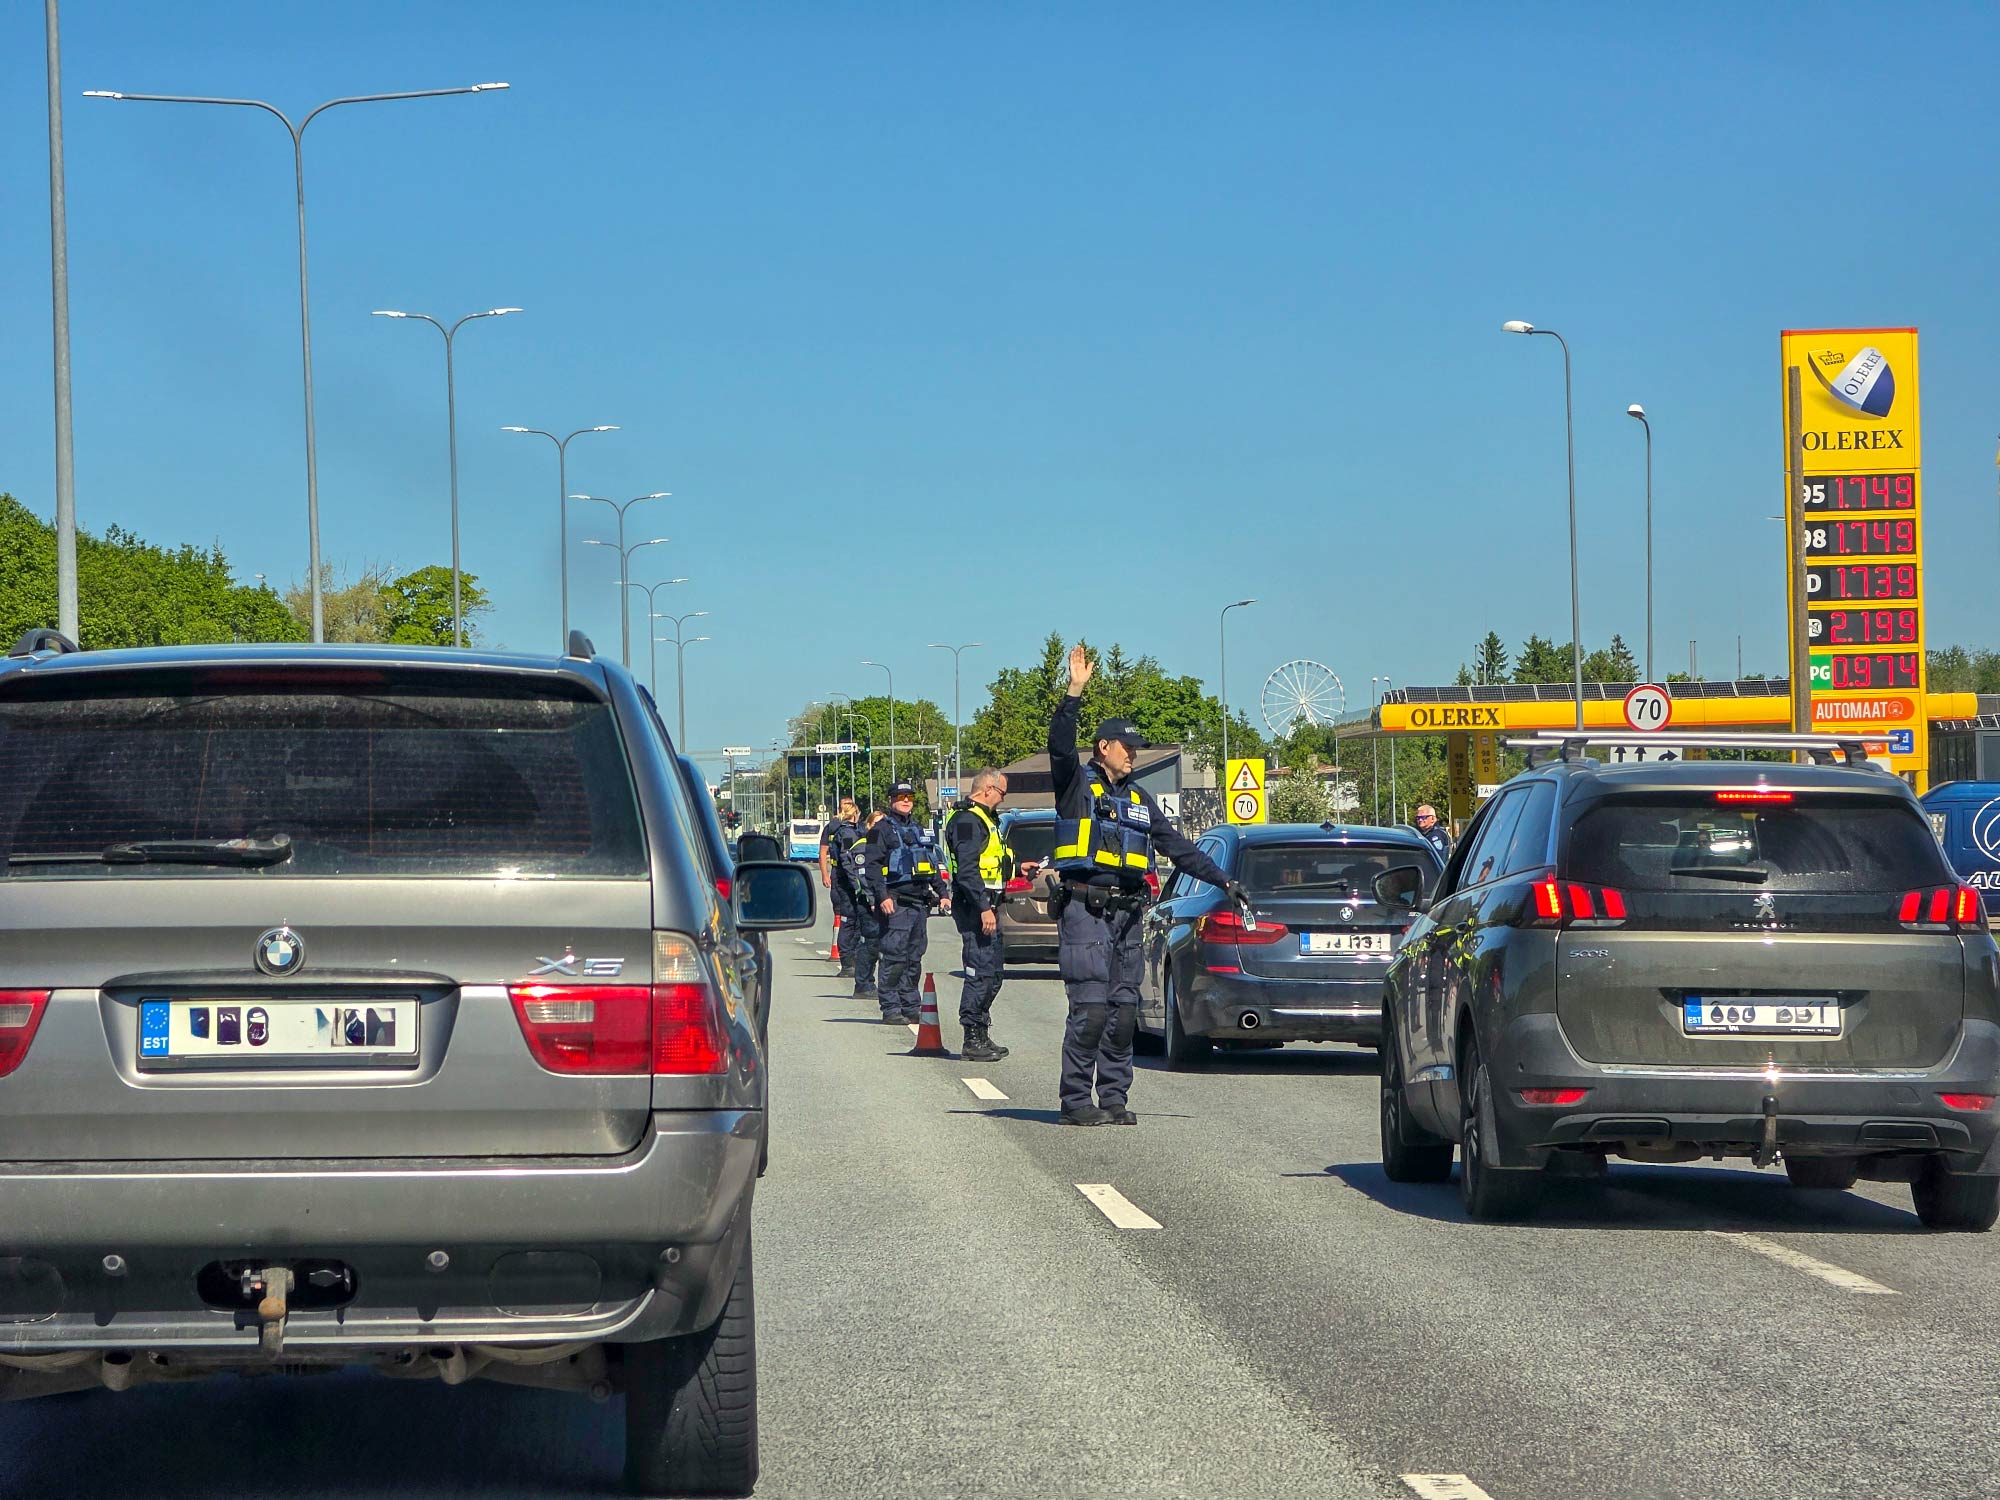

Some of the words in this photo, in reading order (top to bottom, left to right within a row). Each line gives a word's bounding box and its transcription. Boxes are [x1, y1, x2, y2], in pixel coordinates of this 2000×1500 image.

[1802, 430, 1904, 451] OLEREX
[1835, 476, 1912, 508] 1.749
[1836, 521, 1913, 553] 1.749
[1836, 565, 1914, 598] 1.739
[1830, 610, 1916, 643] 2.199
[1809, 665, 1831, 681] PG
[1832, 655, 1918, 688] 0.974
[1411, 707, 1500, 727] OLEREX
[1635, 698, 1662, 721] 70
[1816, 701, 1889, 719] AUTOMAAT
[1238, 800, 1253, 813] 70
[263, 934, 297, 948] BMW
[527, 955, 625, 977] X5
[1687, 1016, 1702, 1025] EST
[143, 1036, 169, 1049] EST
